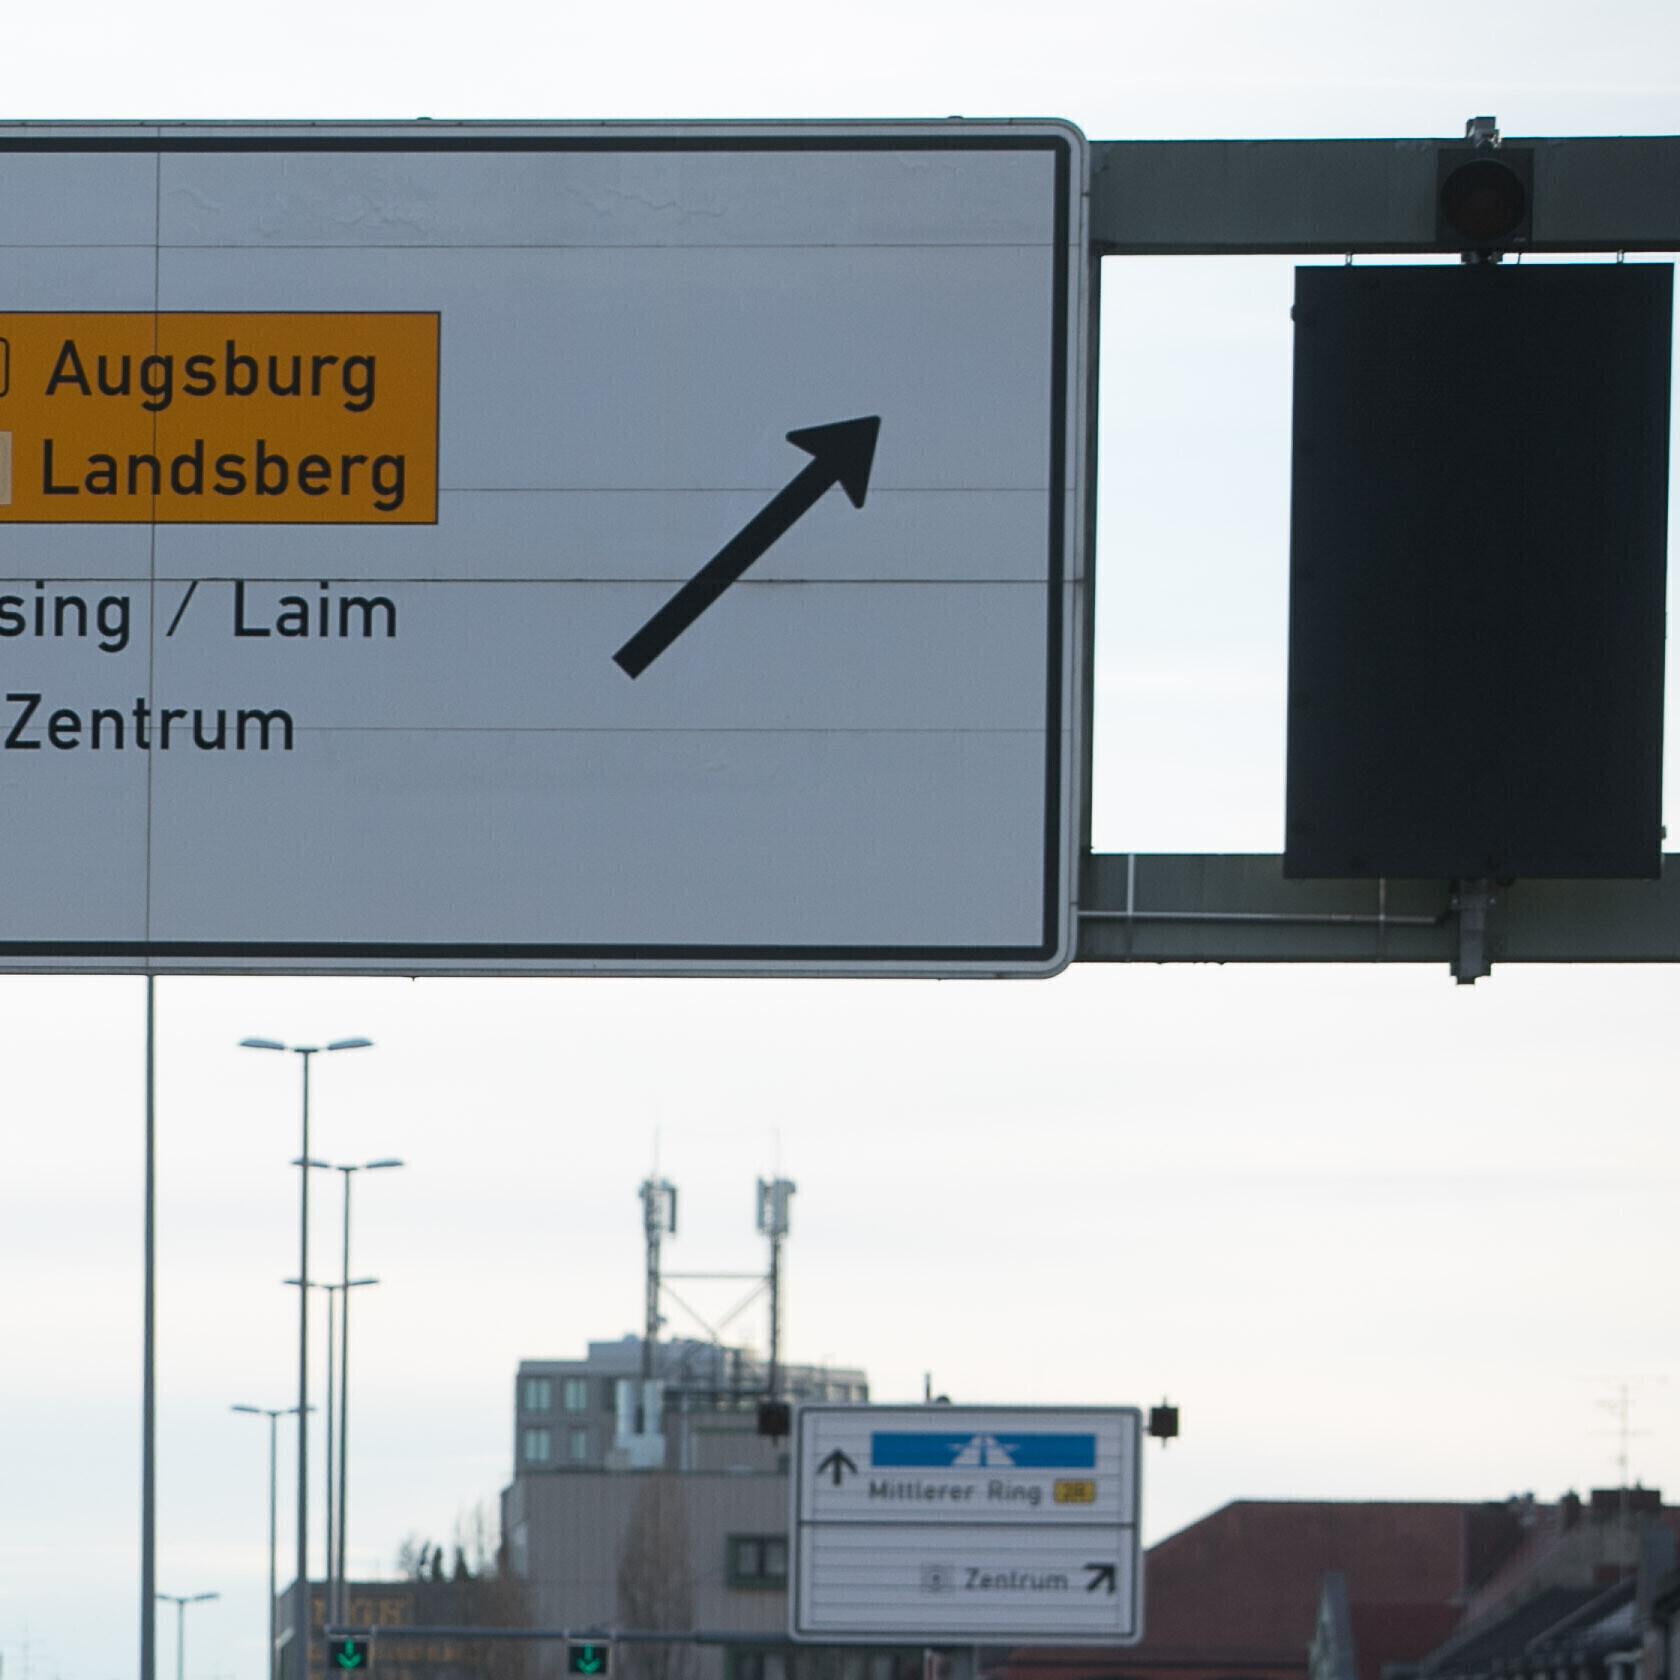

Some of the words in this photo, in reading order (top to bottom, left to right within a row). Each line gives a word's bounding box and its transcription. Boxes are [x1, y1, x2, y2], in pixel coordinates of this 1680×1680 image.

[45, 339, 377, 412] Augsburg
[42, 438, 406, 512] Landsberg
[166, 580, 199, 637] /
[234, 580, 397, 637] Laim
[4, 693, 294, 750] Zentrum
[869, 1479, 974, 1501] Mittlerer
[987, 1479, 1042, 1506] Ring
[965, 1567, 1069, 1591] Zentrum
